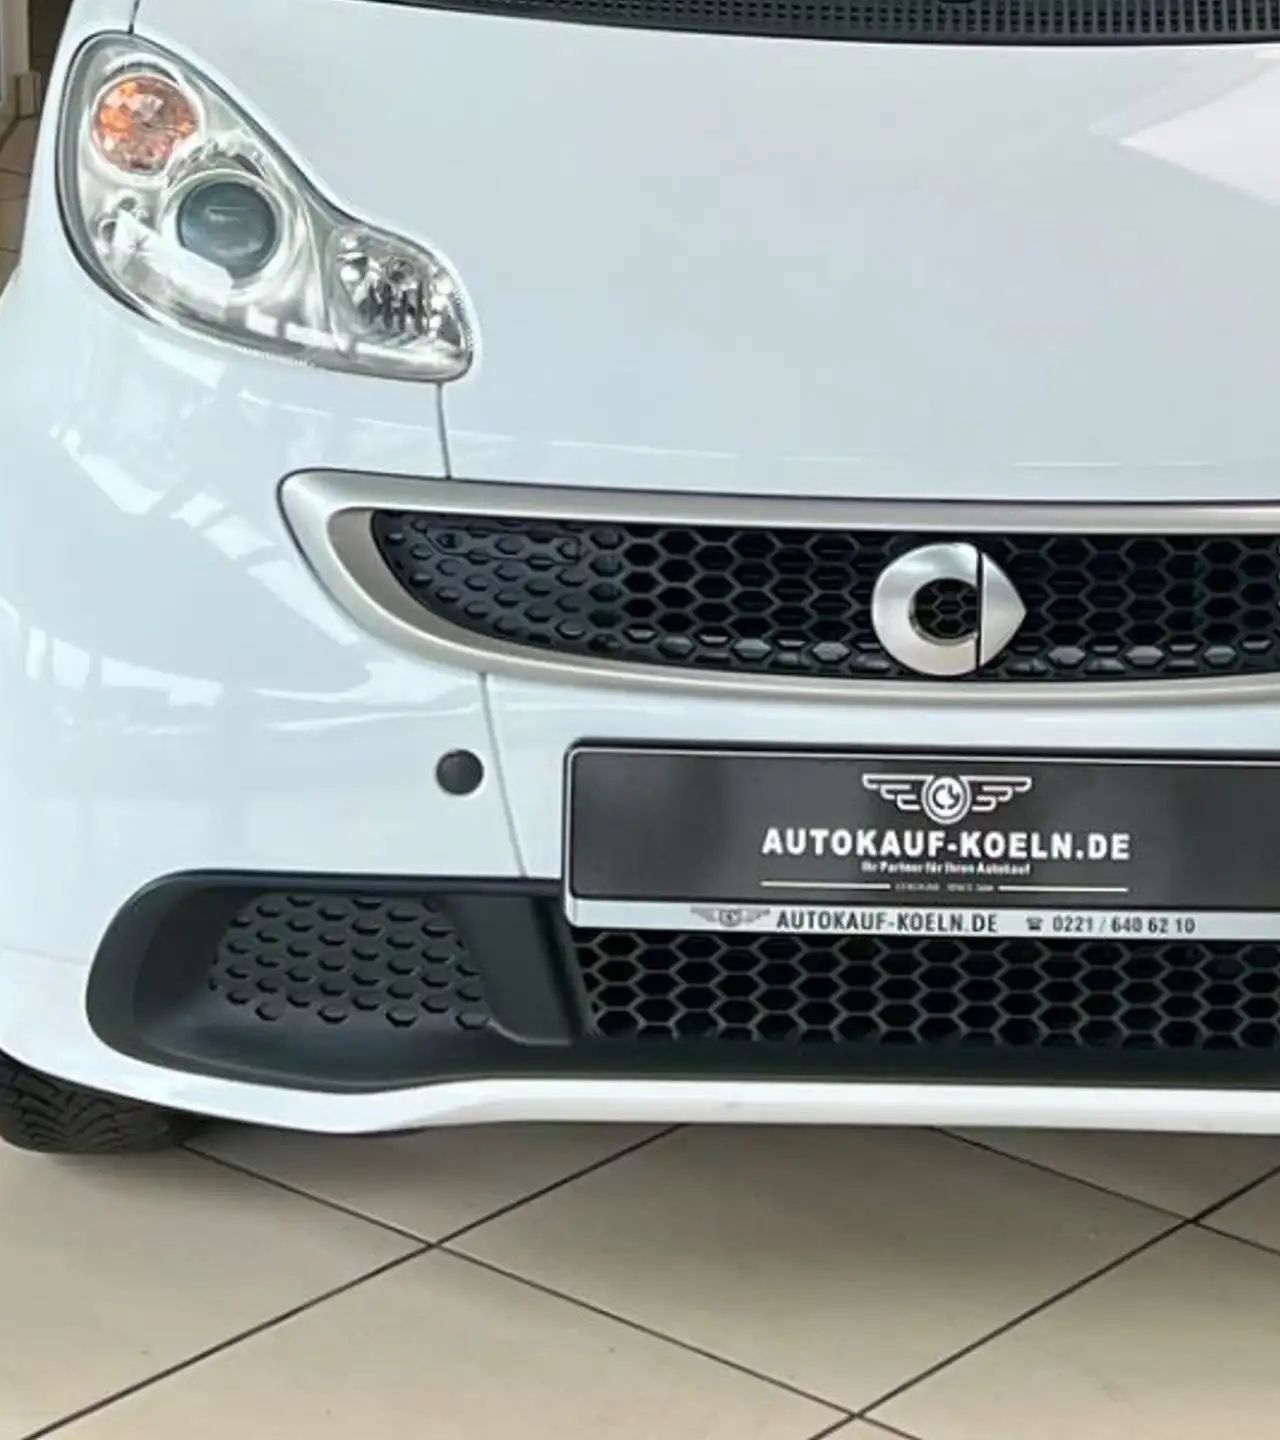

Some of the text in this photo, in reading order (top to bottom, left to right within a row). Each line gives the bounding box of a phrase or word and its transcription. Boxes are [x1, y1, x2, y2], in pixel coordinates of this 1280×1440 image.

[761, 828, 1131, 860] AUTOKAUF-KOELN.DE
[776, 911, 998, 933] AUTOKAUF-KOELN.DE
[1052, 915, 1094, 933] 0221
[1148, 917, 1169, 934] 62
[1175, 918, 1196, 934] 10
